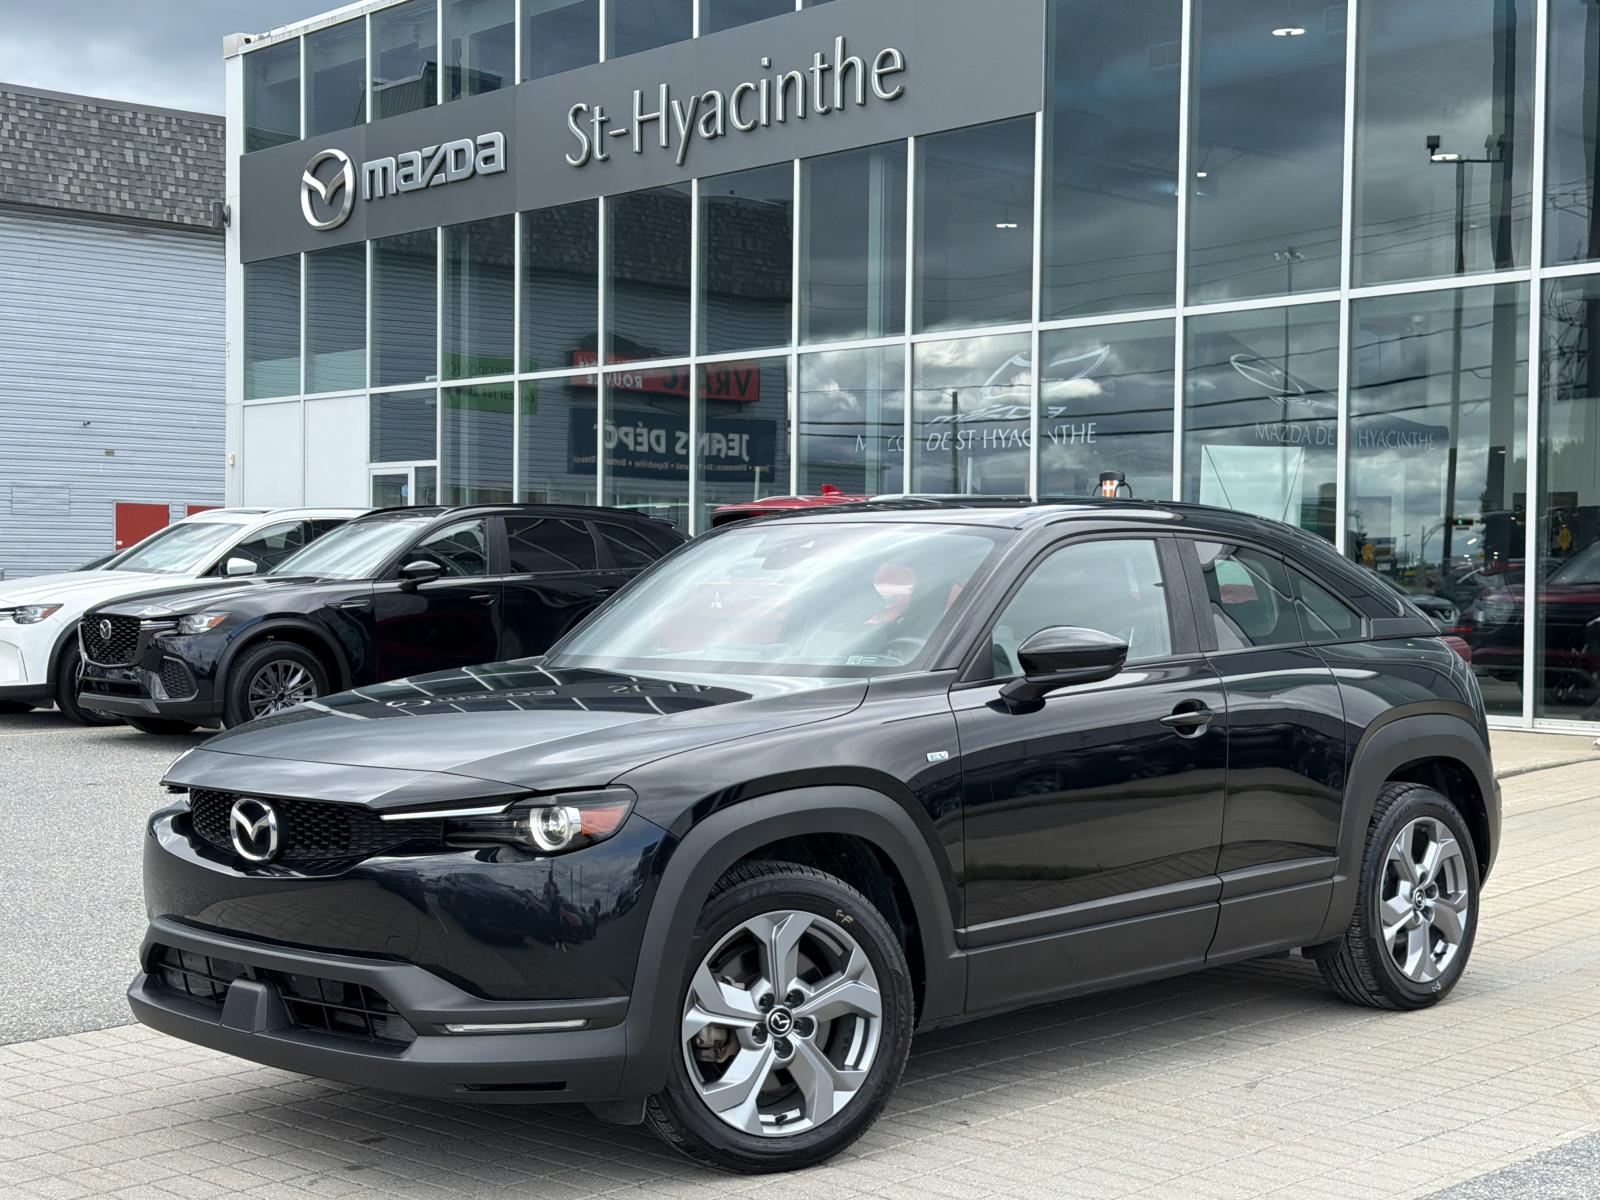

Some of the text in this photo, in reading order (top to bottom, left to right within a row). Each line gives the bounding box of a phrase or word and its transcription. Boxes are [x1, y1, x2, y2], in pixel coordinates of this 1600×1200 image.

[565, 36, 906, 167] St-Hyacinthe
[361, 130, 507, 201] mazda
[926, 431, 950, 451] DE
[955, 422, 1097, 451] ST-HYACNTHE
[1254, 423, 1436, 450] MAZDA DE HYACINTHE
[928, 751, 947, 761] EV
